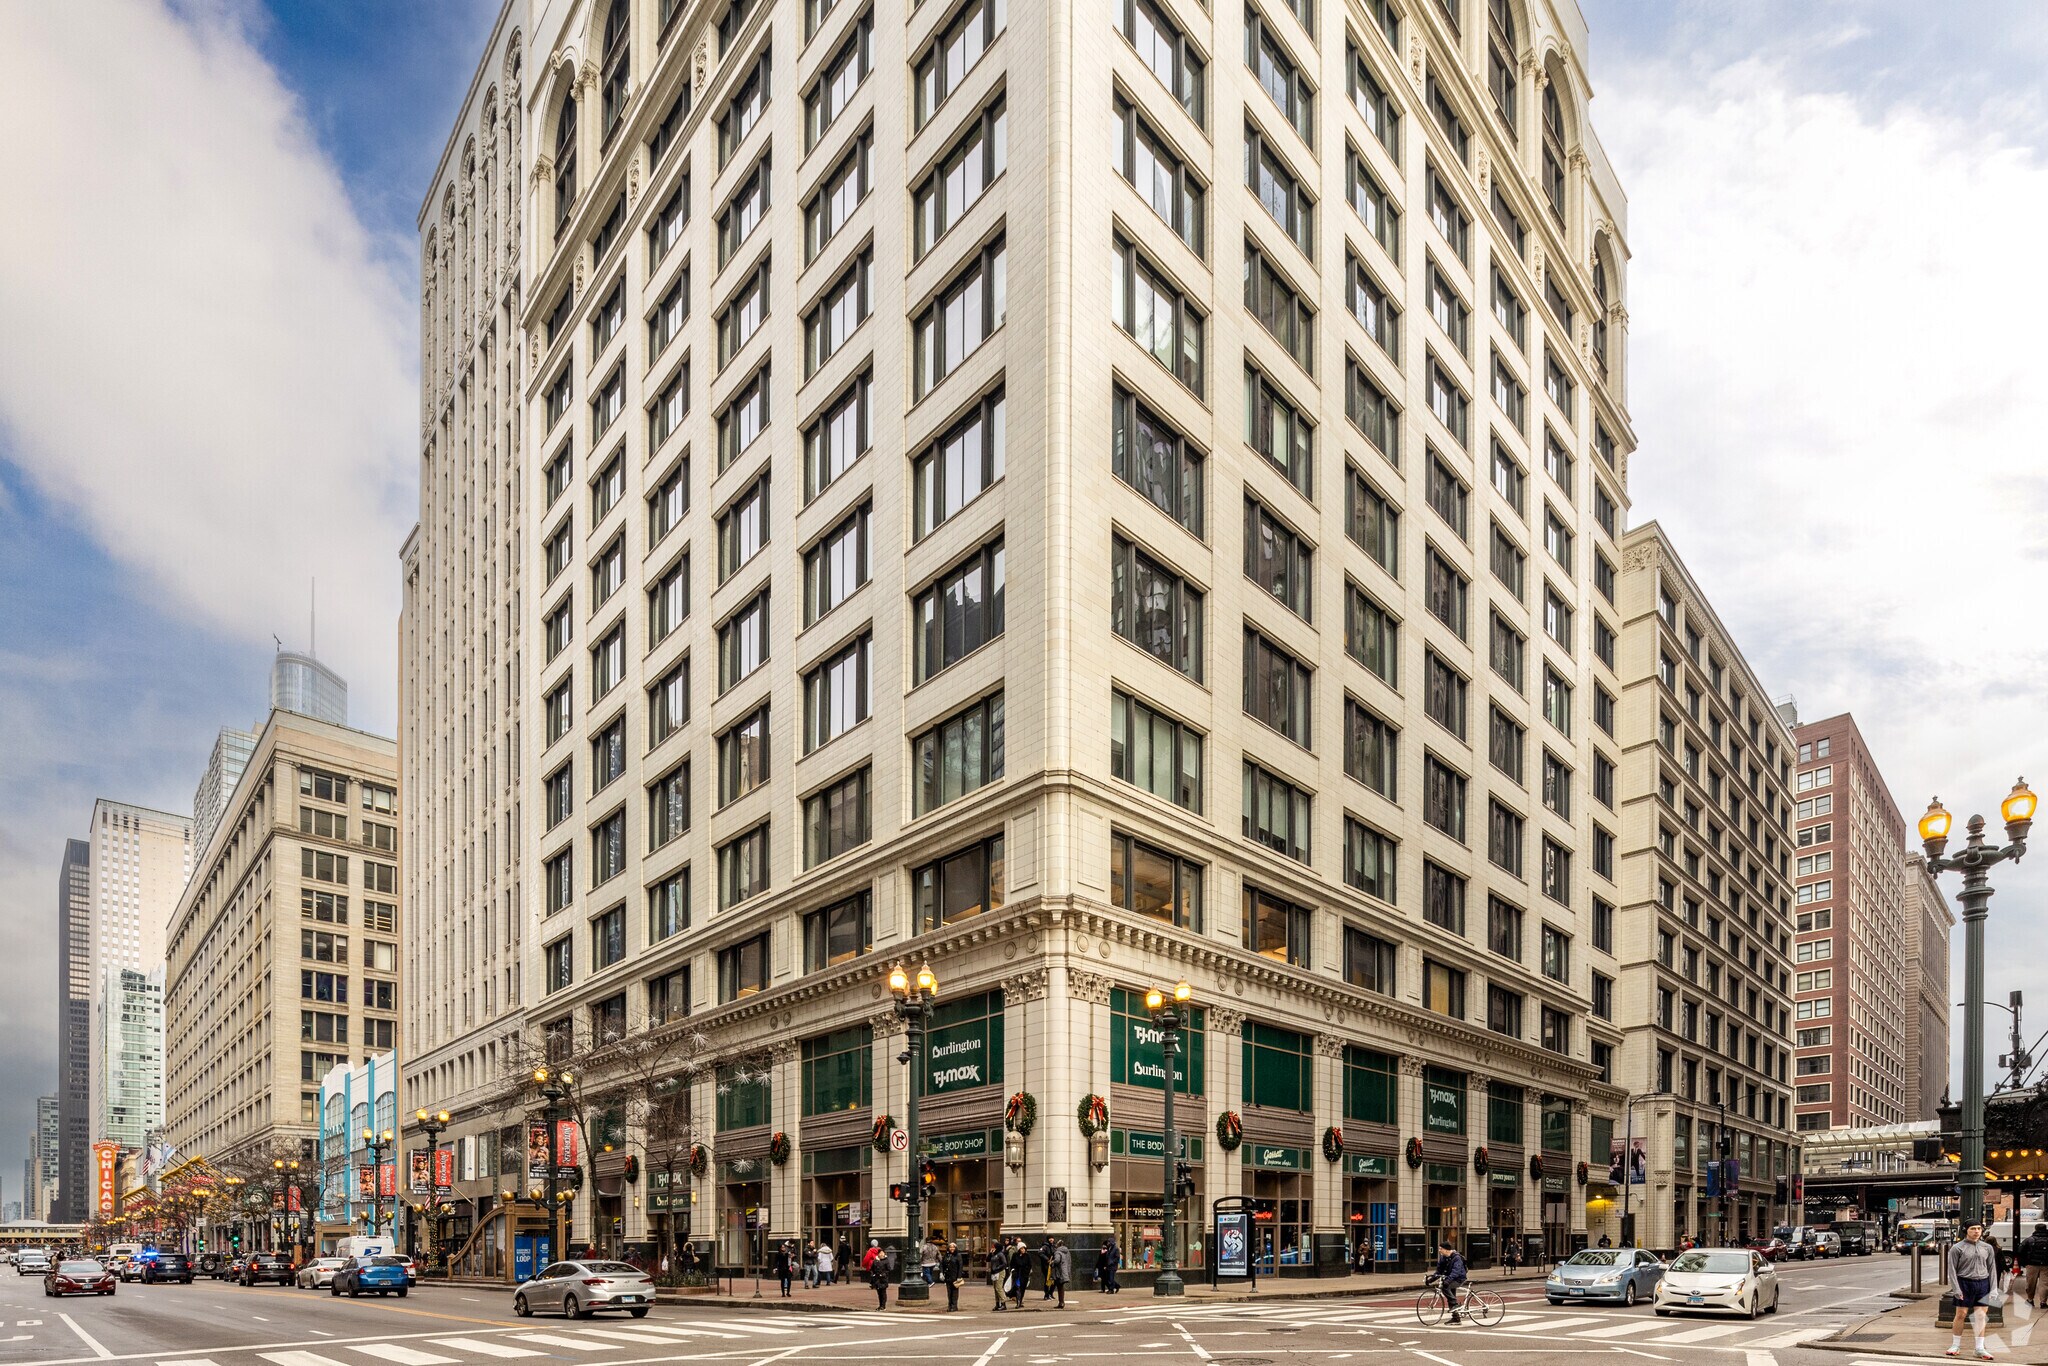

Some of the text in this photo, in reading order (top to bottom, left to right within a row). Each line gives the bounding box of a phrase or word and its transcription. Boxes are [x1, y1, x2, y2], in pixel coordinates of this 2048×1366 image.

[932, 1039, 981, 1059] Burlington
[1134, 1061, 1182, 1081] Burlinon
[944, 1140, 964, 1151] BODY
[964, 1138, 984, 1149] SHOP
[1132, 1139, 1145, 1149] THE
